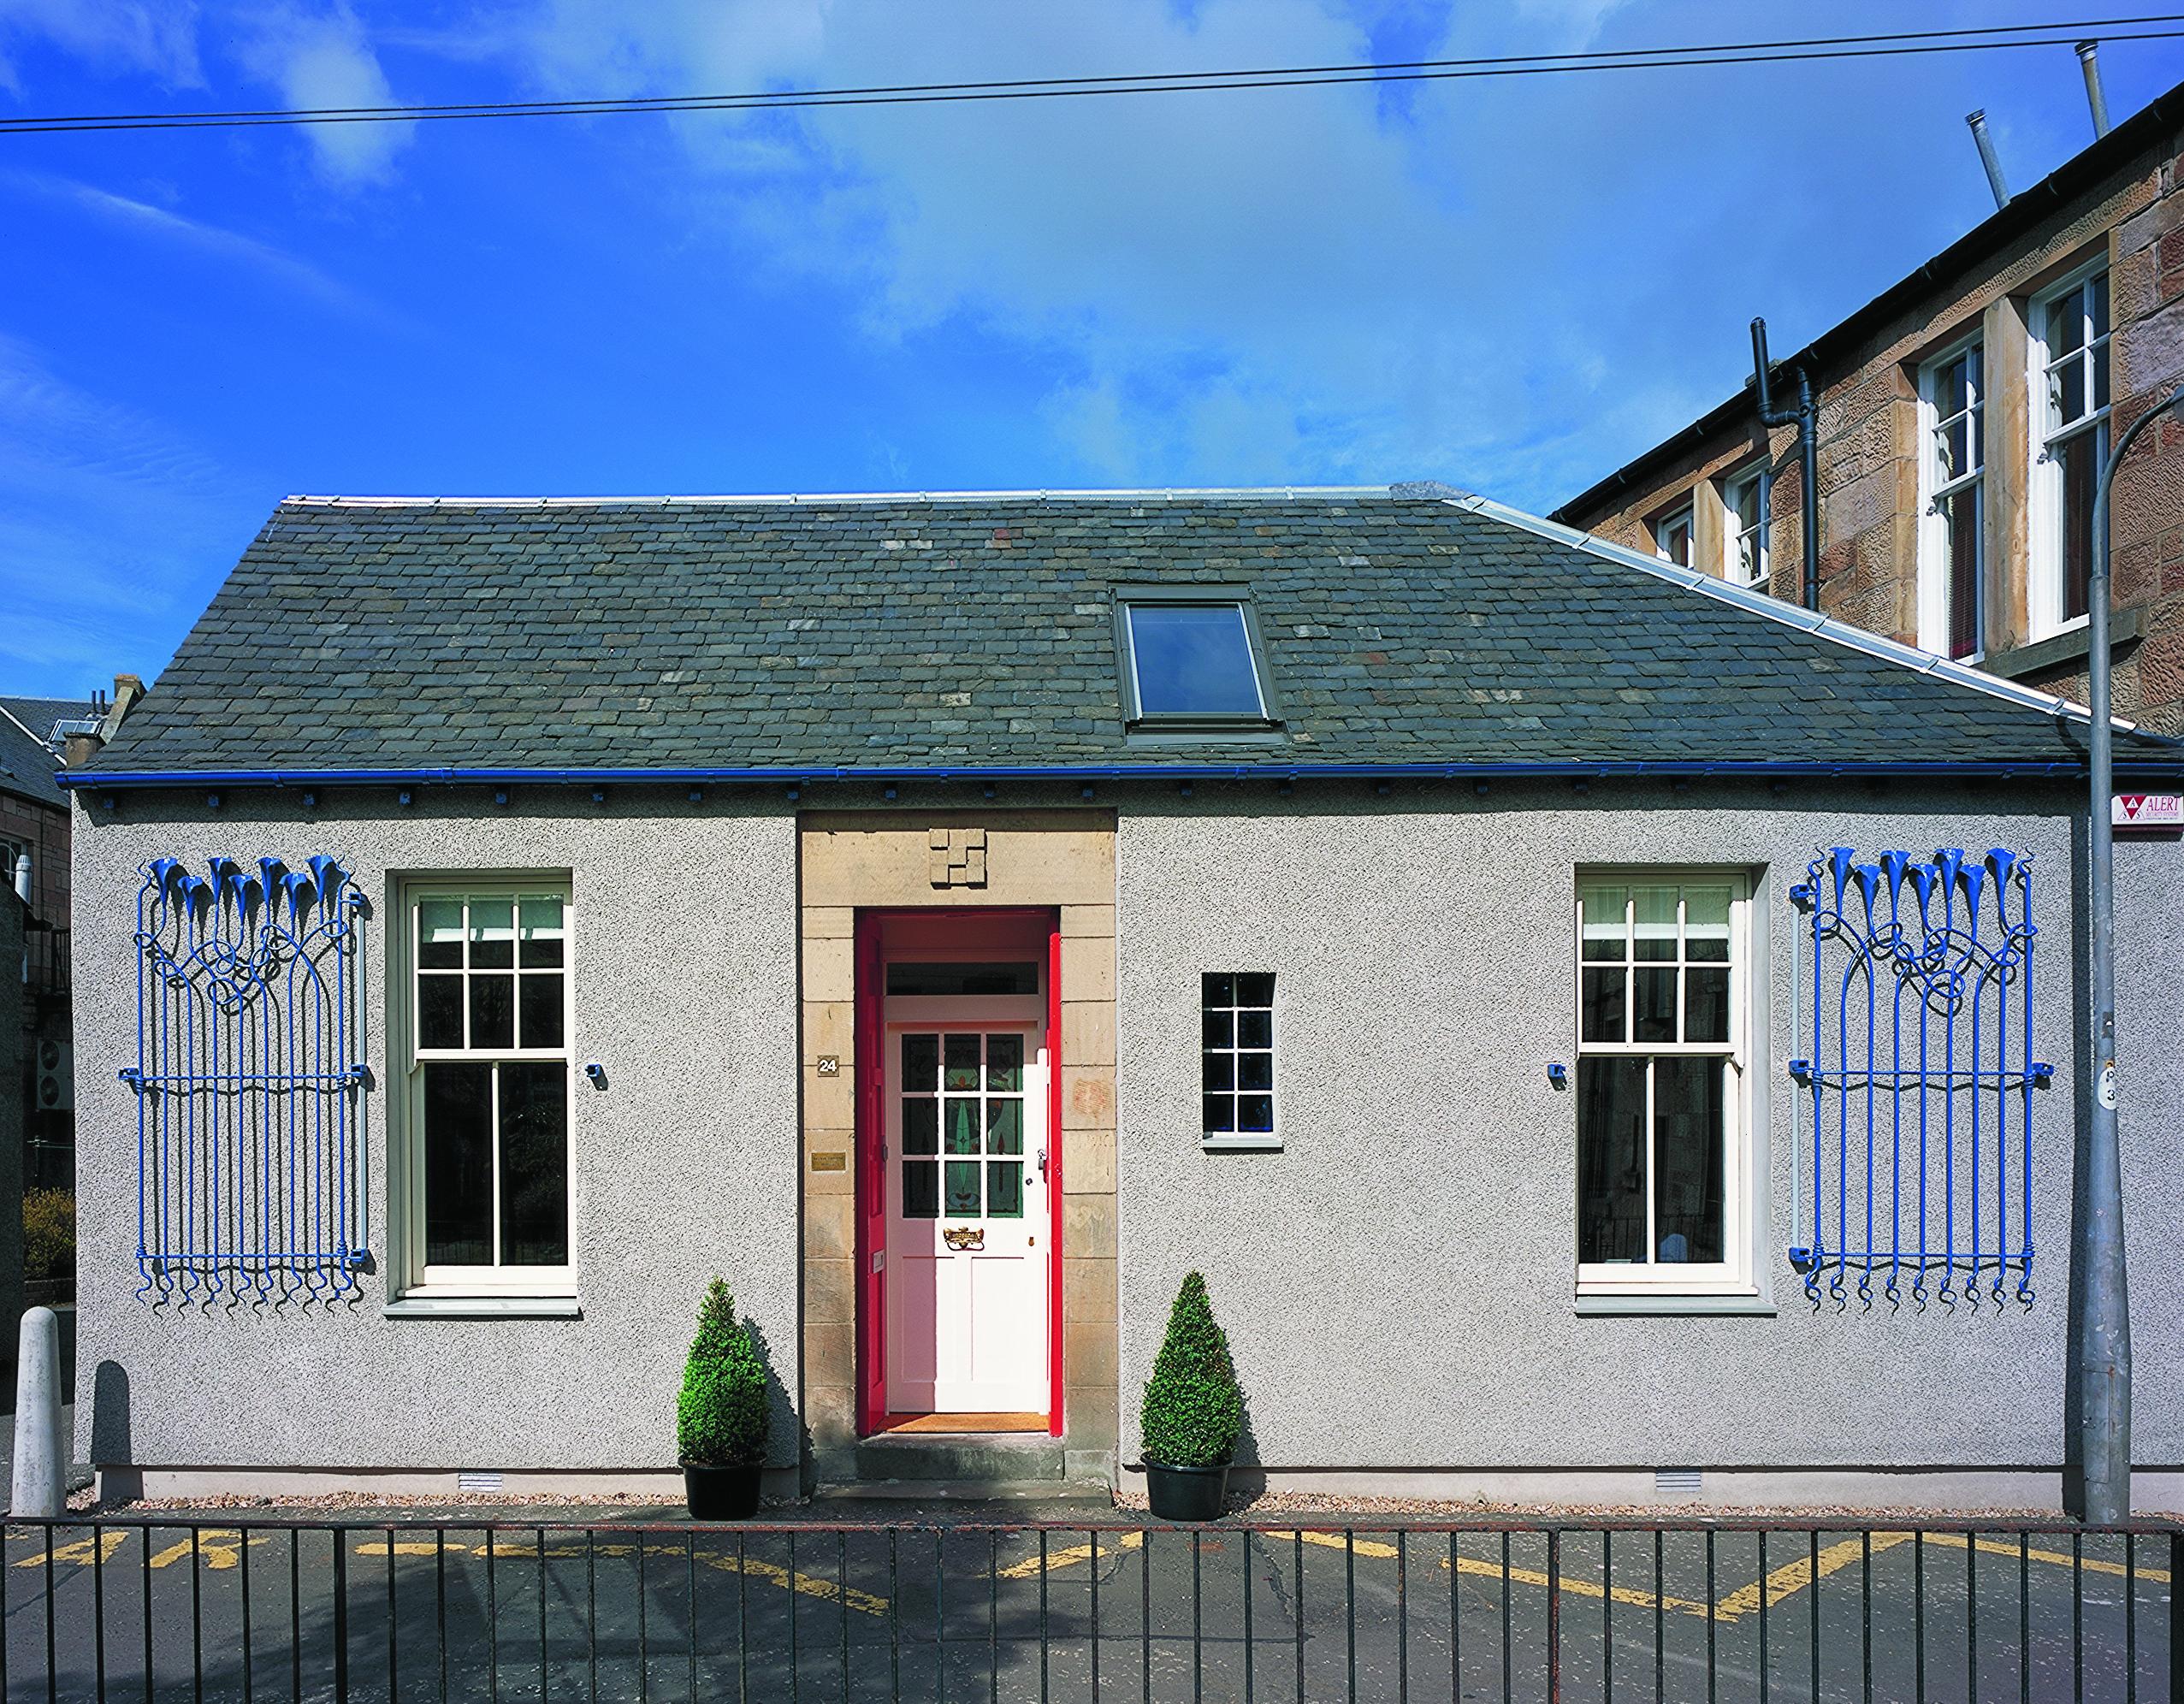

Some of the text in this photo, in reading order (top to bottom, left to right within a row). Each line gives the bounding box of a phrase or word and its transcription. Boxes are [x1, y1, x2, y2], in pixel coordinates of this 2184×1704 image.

[2146, 796, 2179, 811] ALERT
[819, 1059, 837, 1072] 24
[2107, 1089, 2115, 1101] 3
[4, 1529, 271, 1569] AR
